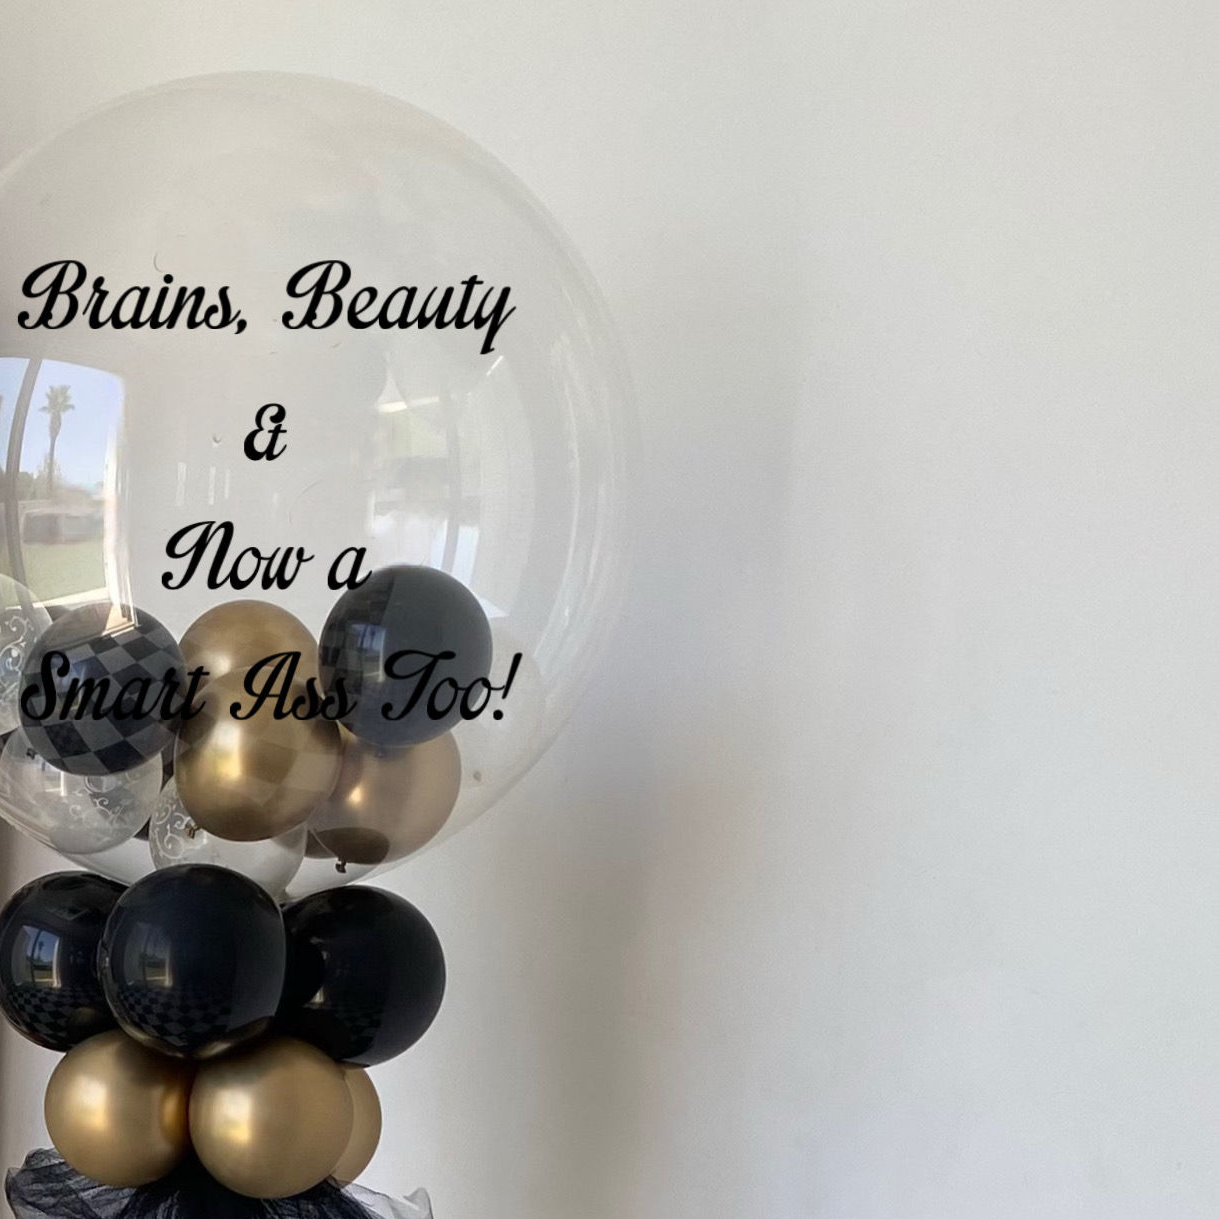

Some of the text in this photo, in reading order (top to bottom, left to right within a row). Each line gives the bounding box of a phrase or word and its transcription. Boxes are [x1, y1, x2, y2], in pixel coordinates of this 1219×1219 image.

[17, 260, 517, 355] Brains, Beauty
[243, 403, 287, 461] &
[161, 521, 373, 590] Now a
[20, 649, 523, 721] Smart Ass Too!
